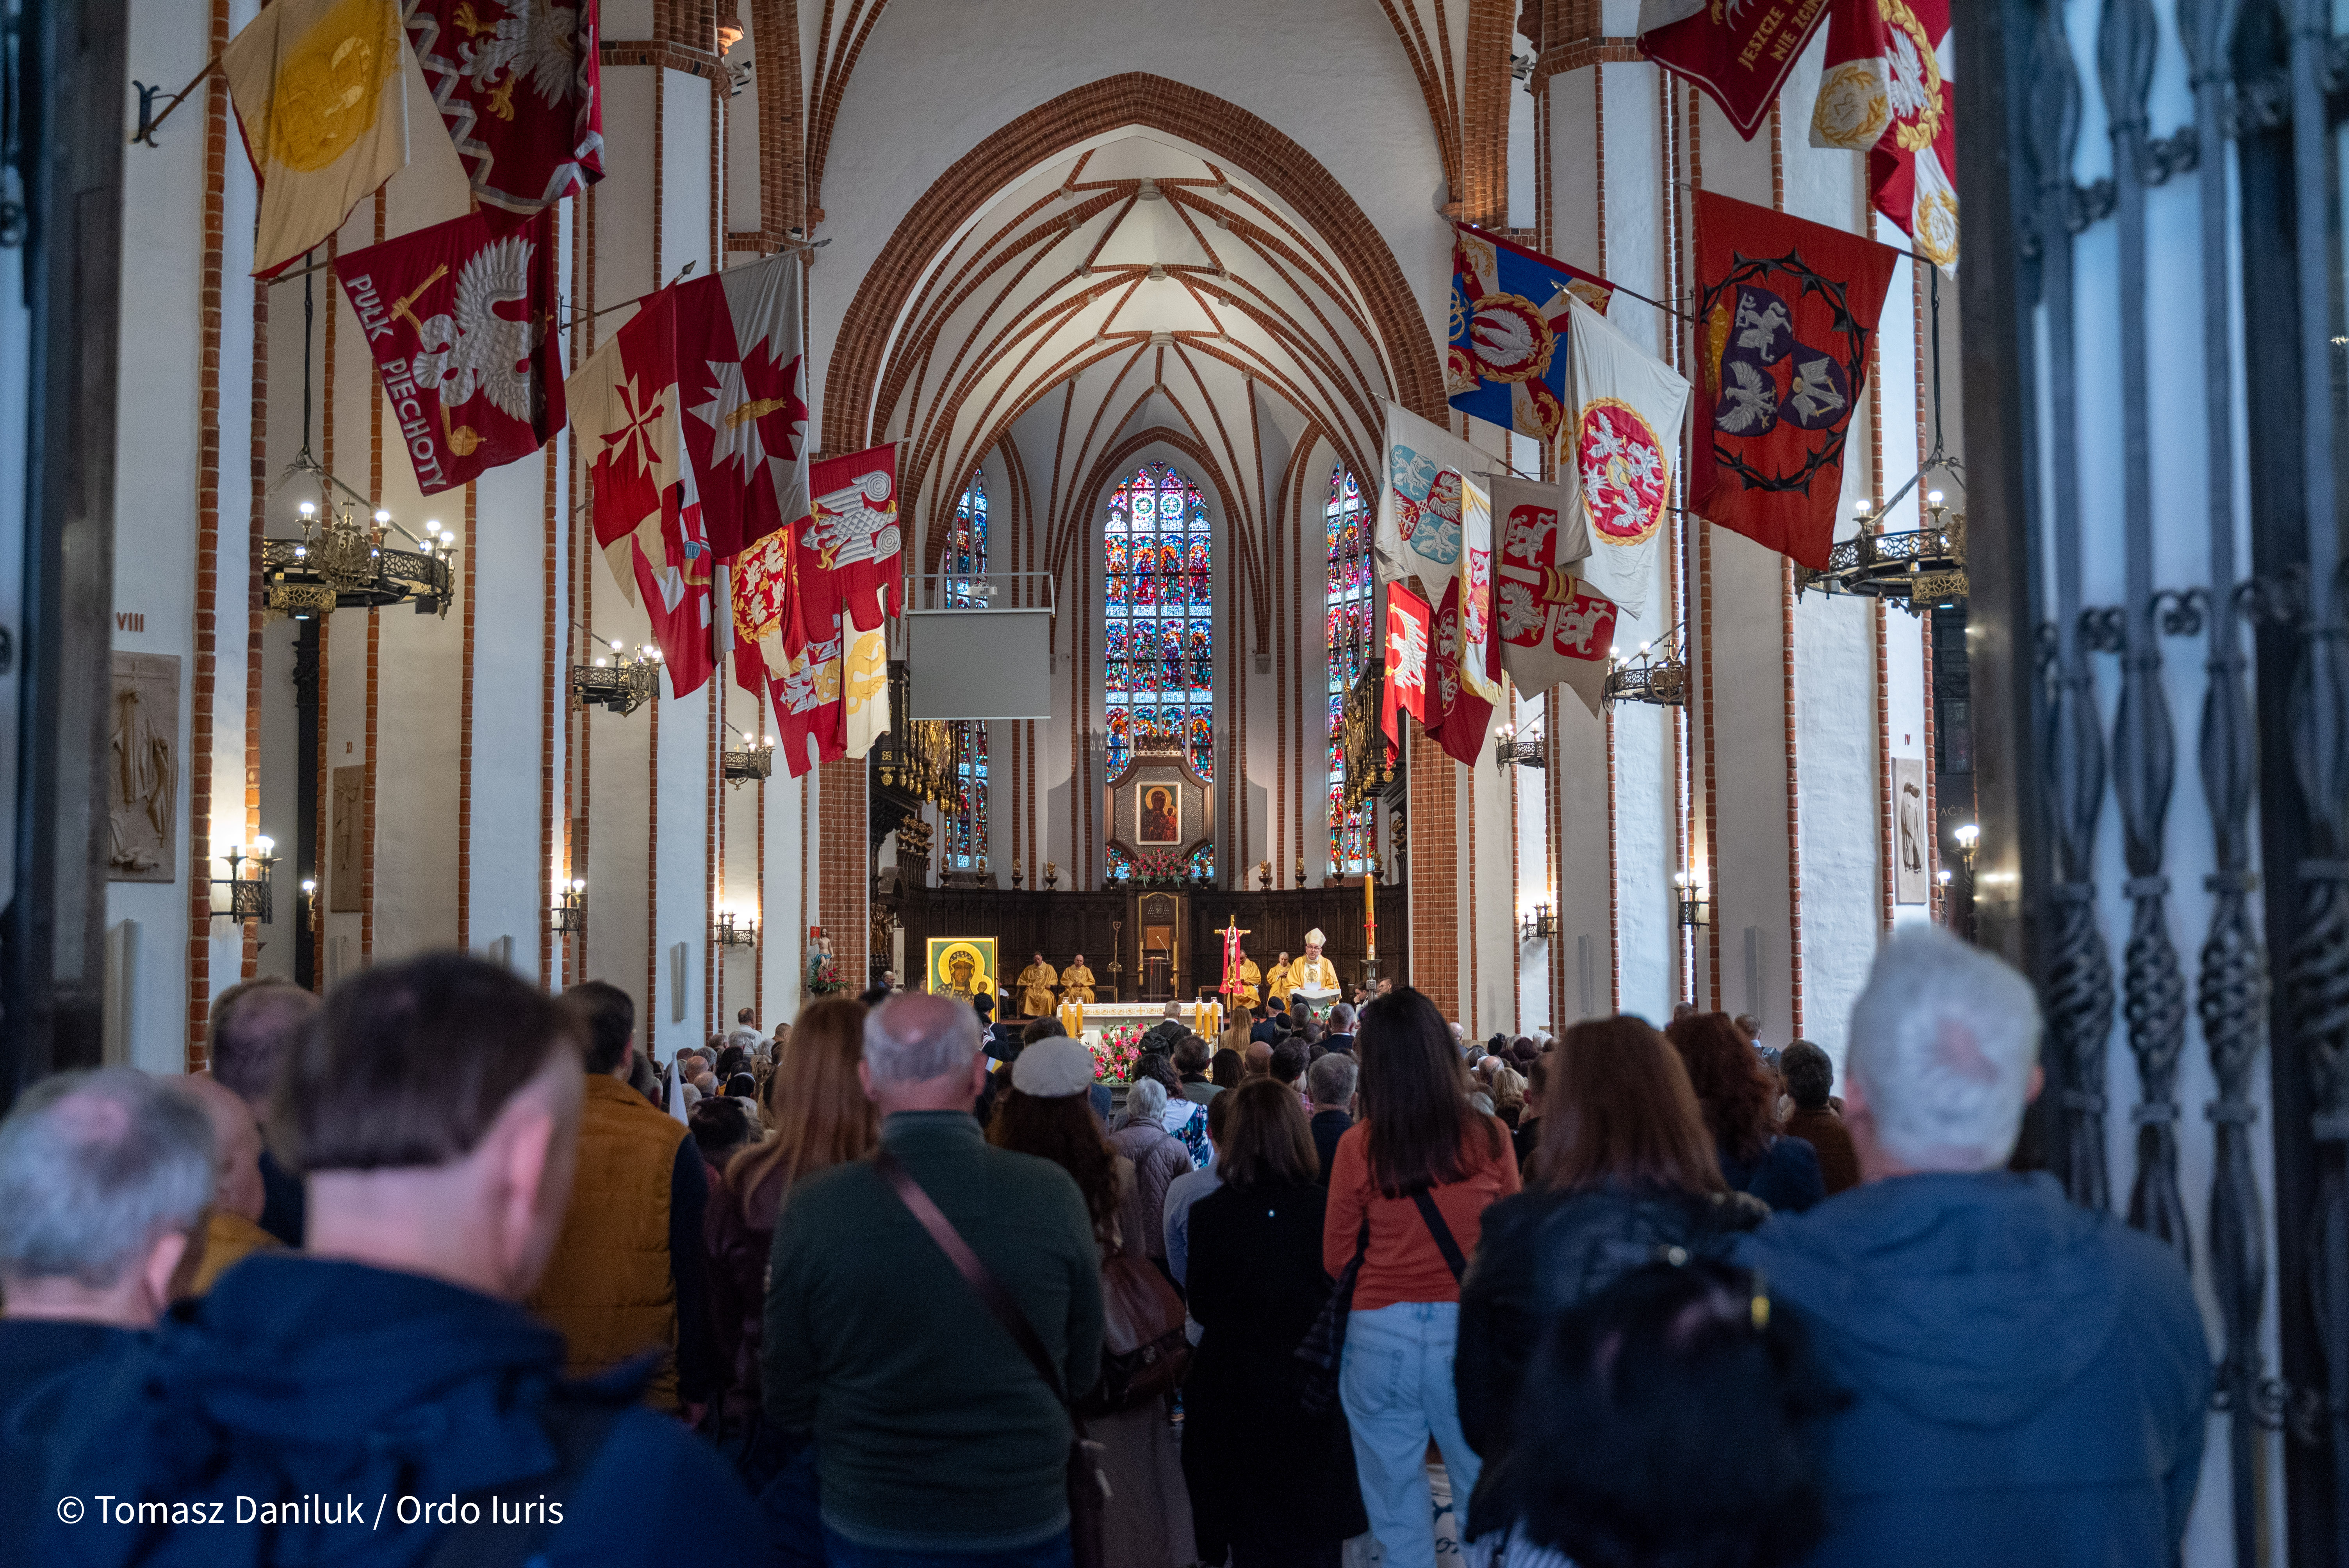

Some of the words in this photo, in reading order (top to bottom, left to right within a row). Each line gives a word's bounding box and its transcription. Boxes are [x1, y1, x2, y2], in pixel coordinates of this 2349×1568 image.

[1738, 5, 1786, 73] JESZCZE
[1770, 29, 1797, 62] NIE
[346, 274, 394, 342] PUŁK
[381, 357, 447, 488] PIECHOTY
[116, 612, 144, 633] VIII
[346, 741, 352, 754] XI
